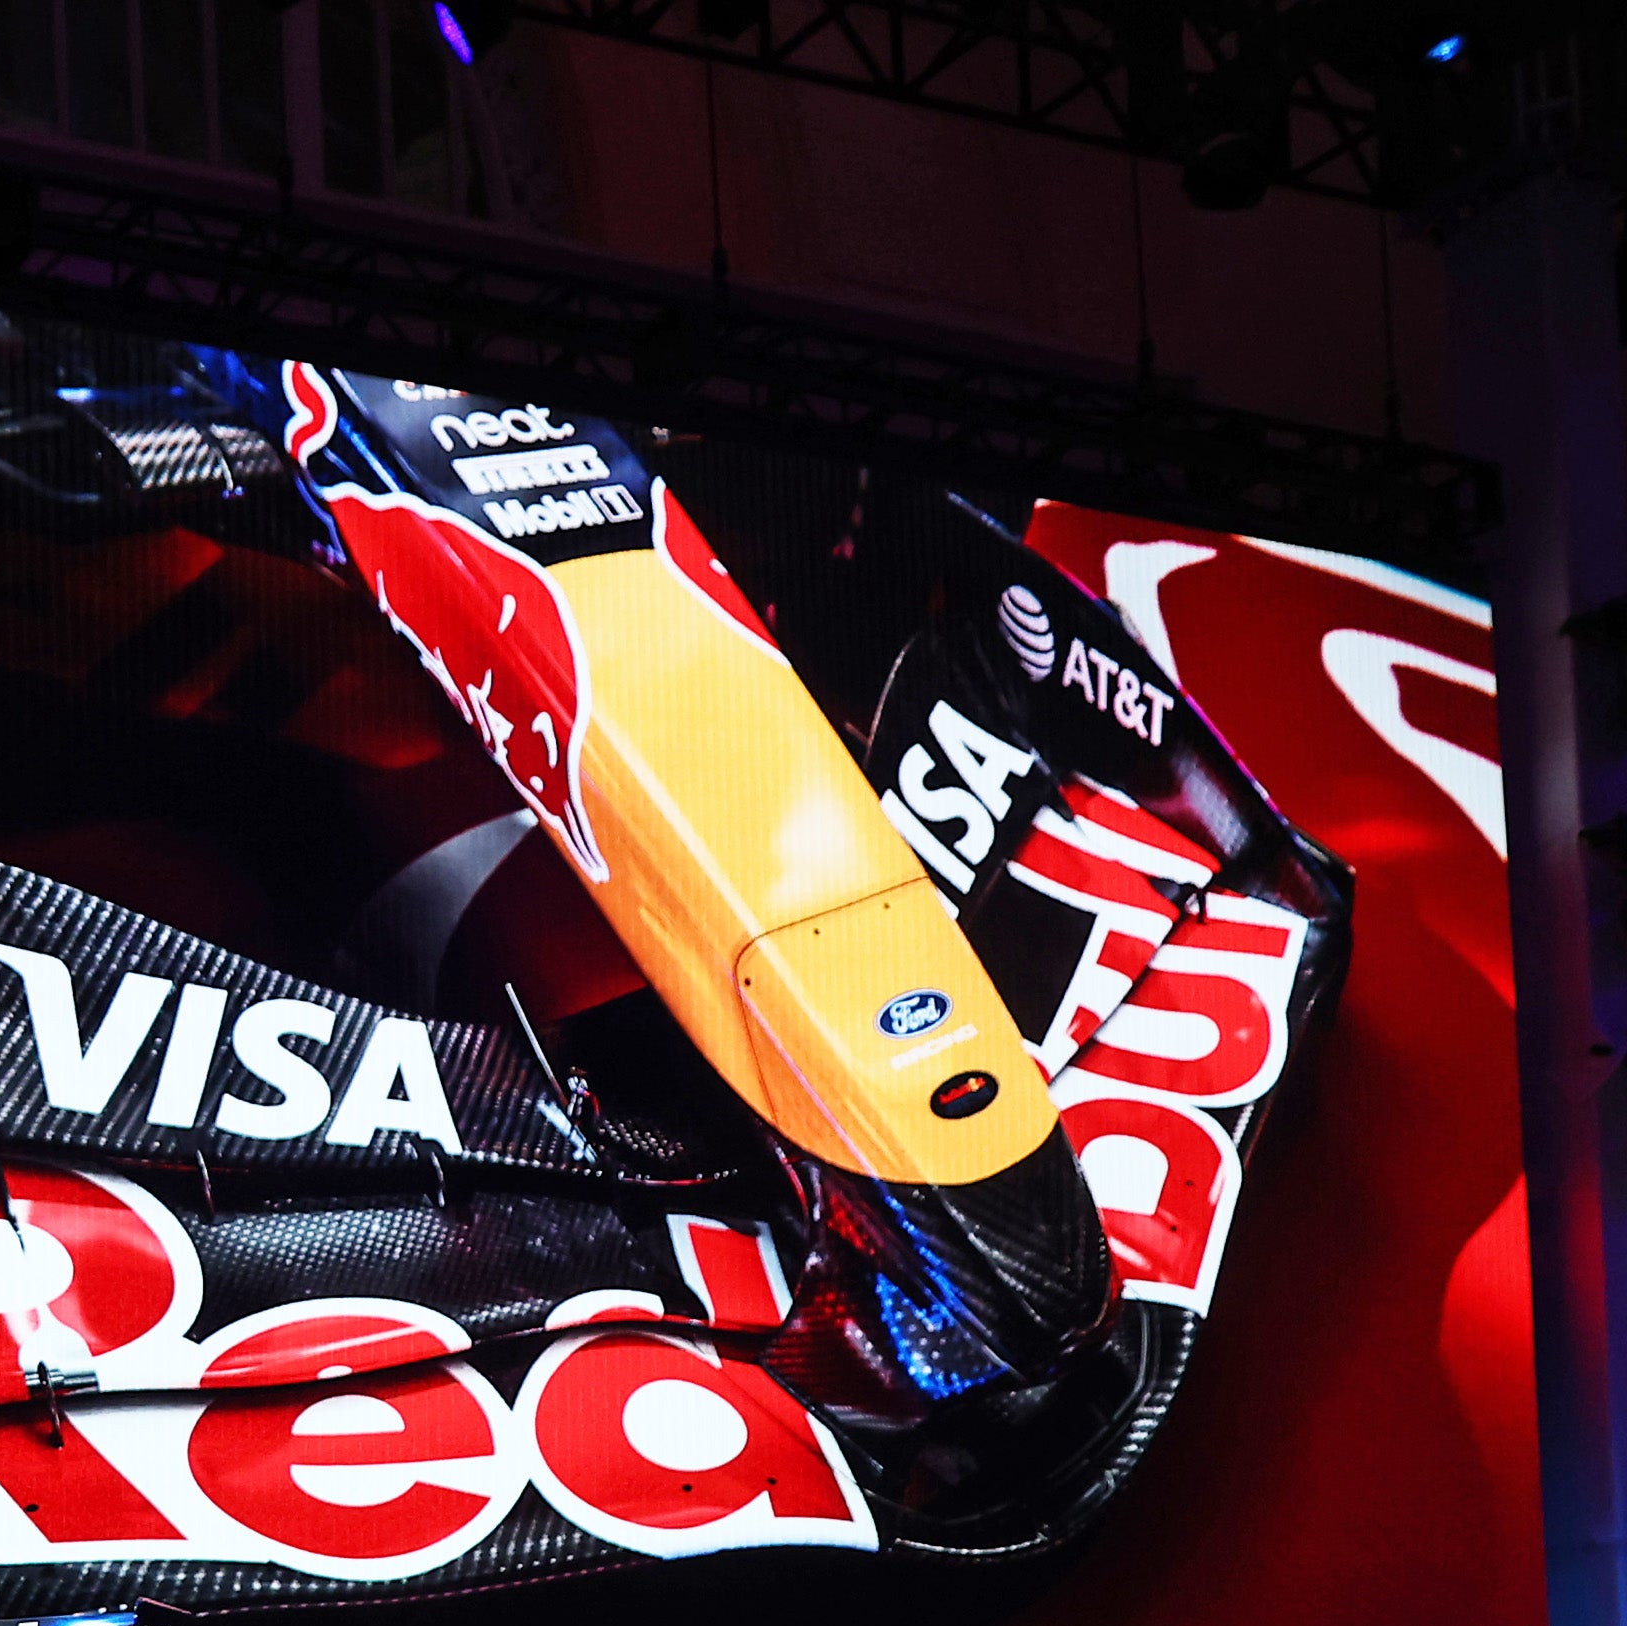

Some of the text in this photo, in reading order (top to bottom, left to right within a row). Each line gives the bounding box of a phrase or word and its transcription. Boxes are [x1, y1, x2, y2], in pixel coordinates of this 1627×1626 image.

[482, 490, 605, 539] Mobil
[1061, 638, 1174, 747] AT&T
[880, 700, 1034, 920] ISA
[890, 997, 940, 1034] Ford
